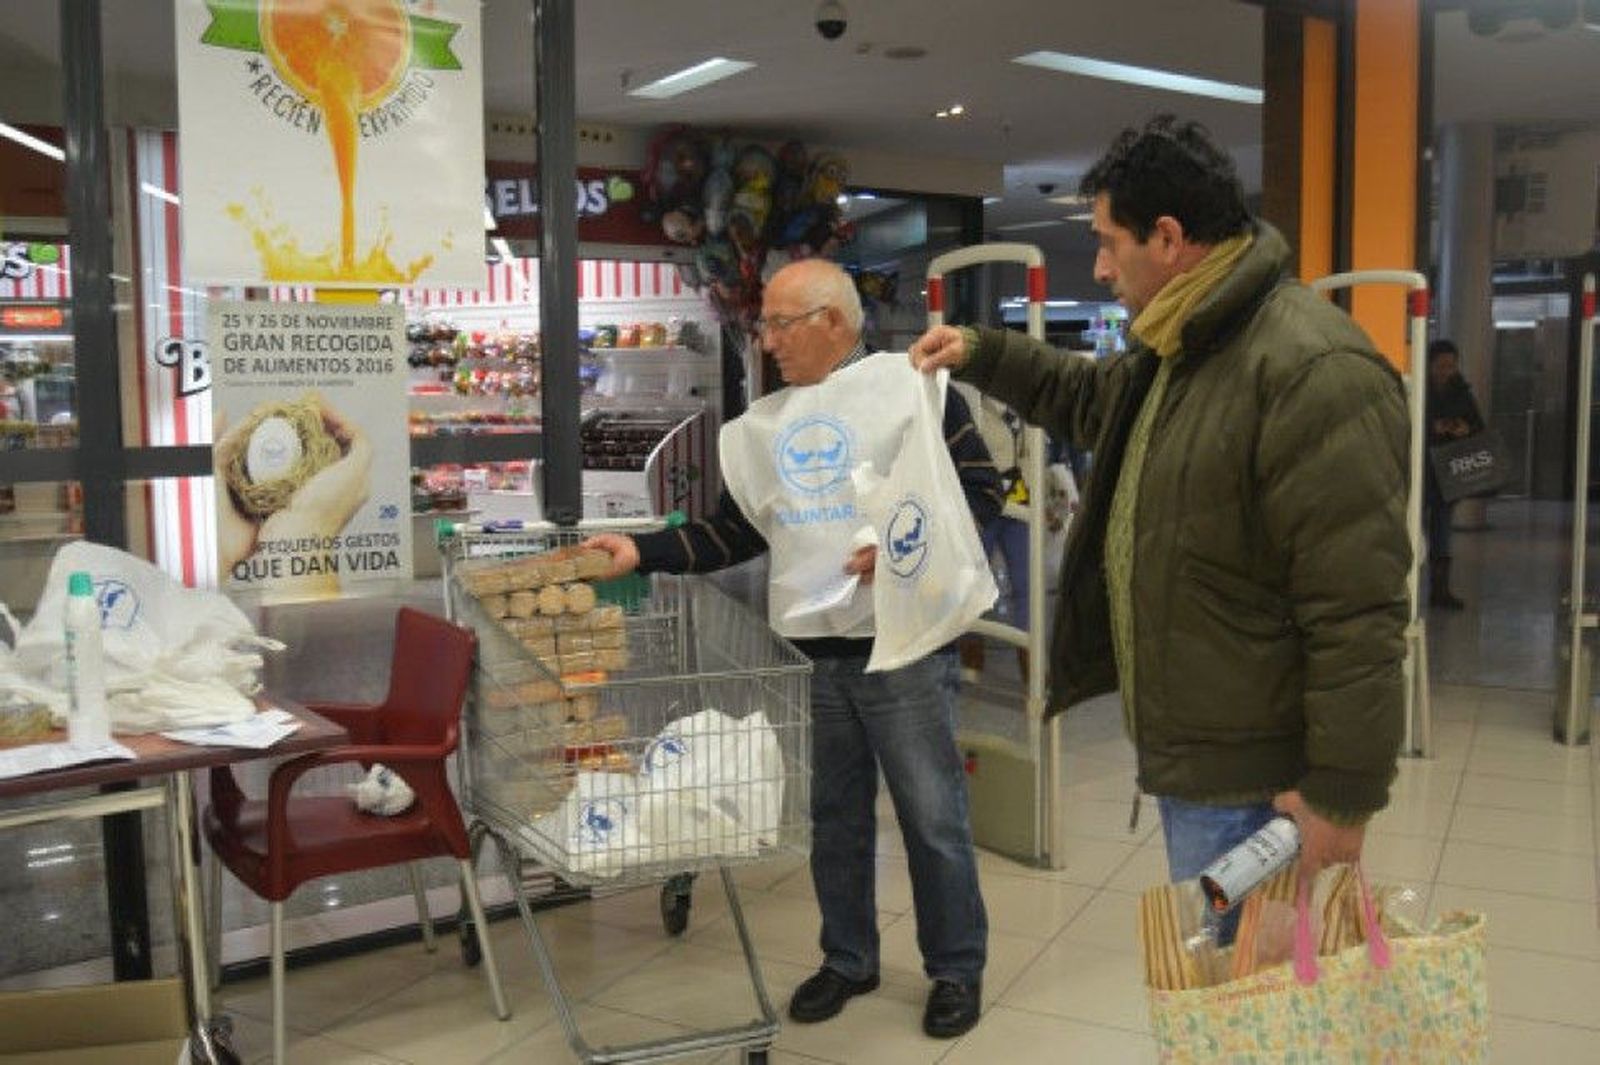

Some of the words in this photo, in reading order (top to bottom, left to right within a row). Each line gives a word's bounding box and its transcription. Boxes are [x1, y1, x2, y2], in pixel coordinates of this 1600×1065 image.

[223, 313, 240, 328] 25
[246, 314, 255, 327] Y
[281, 315, 300, 328] DE
[306, 315, 393, 329] NOVIEMBRE
[224, 332, 284, 351] GRAN
[291, 334, 393, 351] RECOGIDA
[224, 357, 247, 374] DE
[252, 358, 351, 374] ALIMENTOS
[356, 357, 393, 374] 2016
[345, 533, 400, 548] GESTOS
[234, 559, 282, 583] QUE
[290, 554, 339, 577] DAN
[346, 550, 400, 571] VIDA
